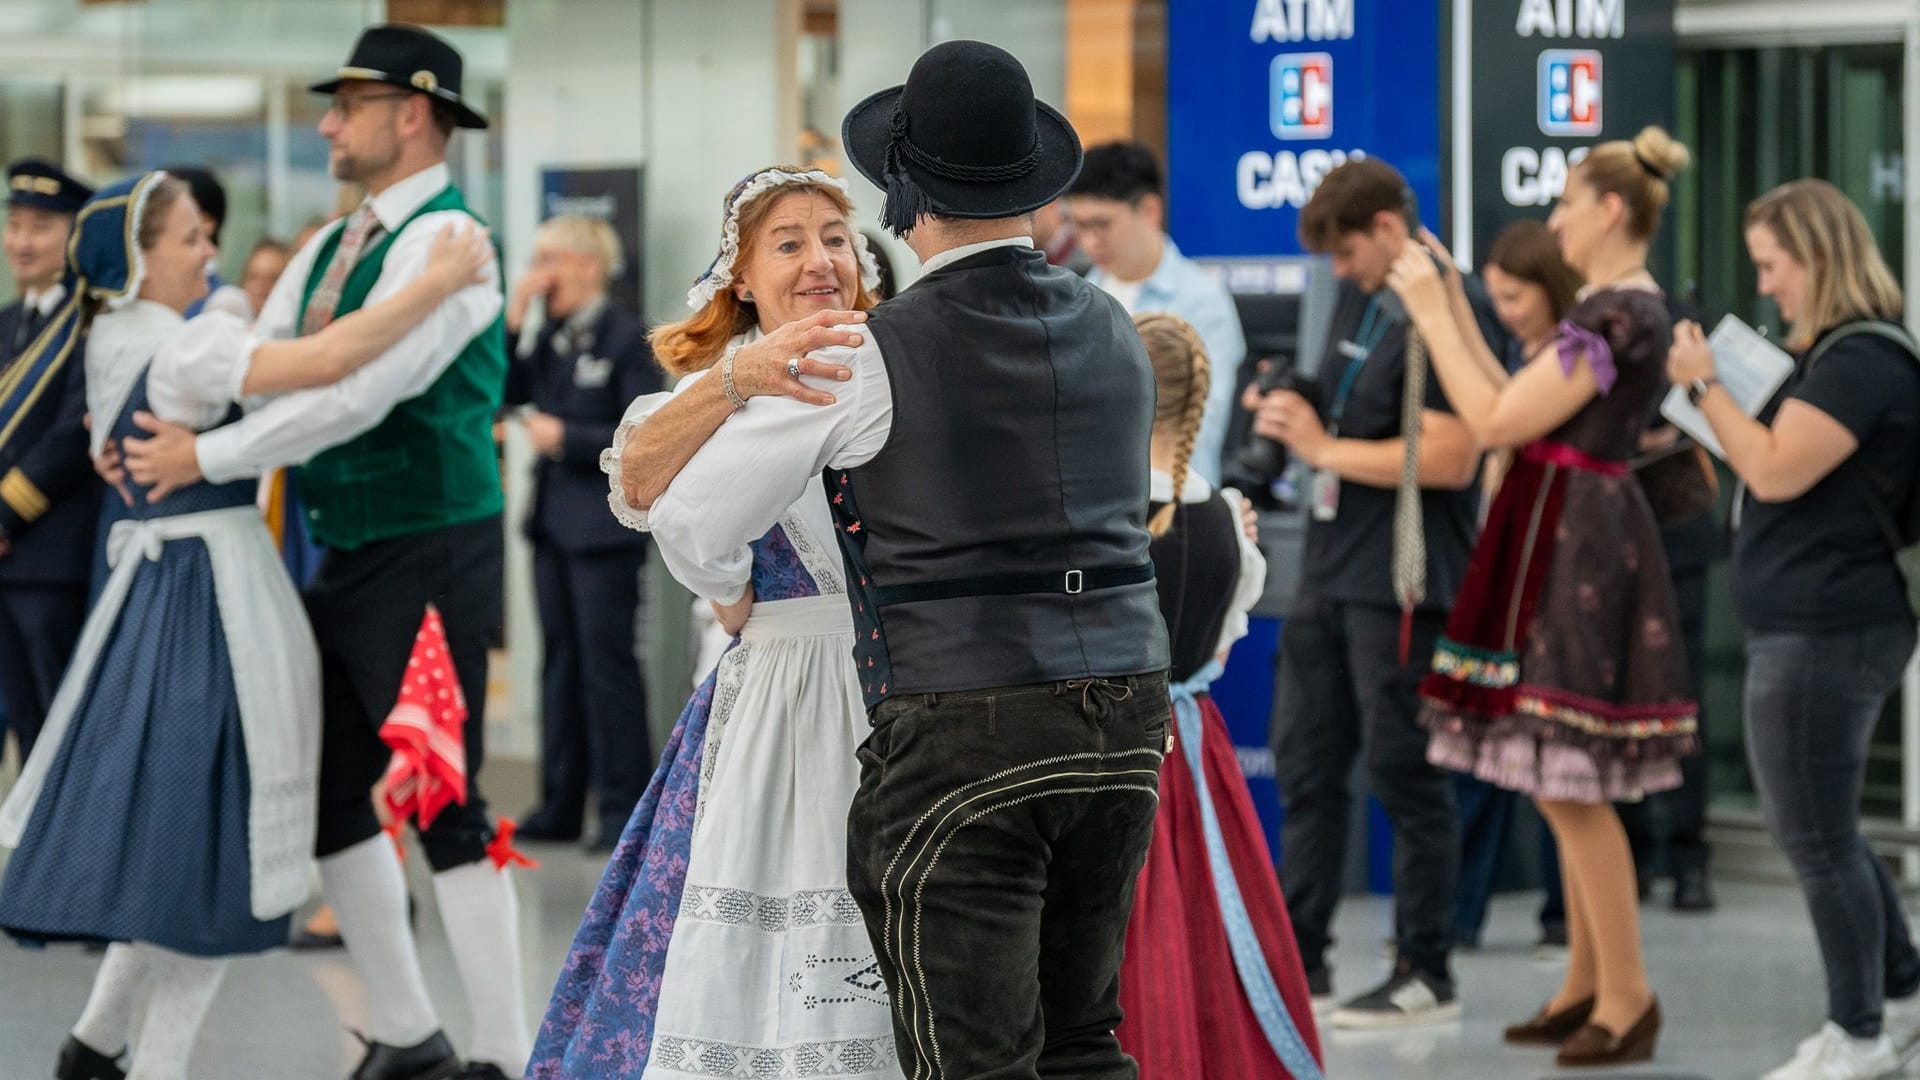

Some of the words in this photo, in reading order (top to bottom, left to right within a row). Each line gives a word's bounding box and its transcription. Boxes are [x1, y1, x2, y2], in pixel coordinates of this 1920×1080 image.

[1250, 0, 1355, 43] ATM
[1515, 0, 1625, 39] ATM
[1236, 149, 1367, 210] CAS
